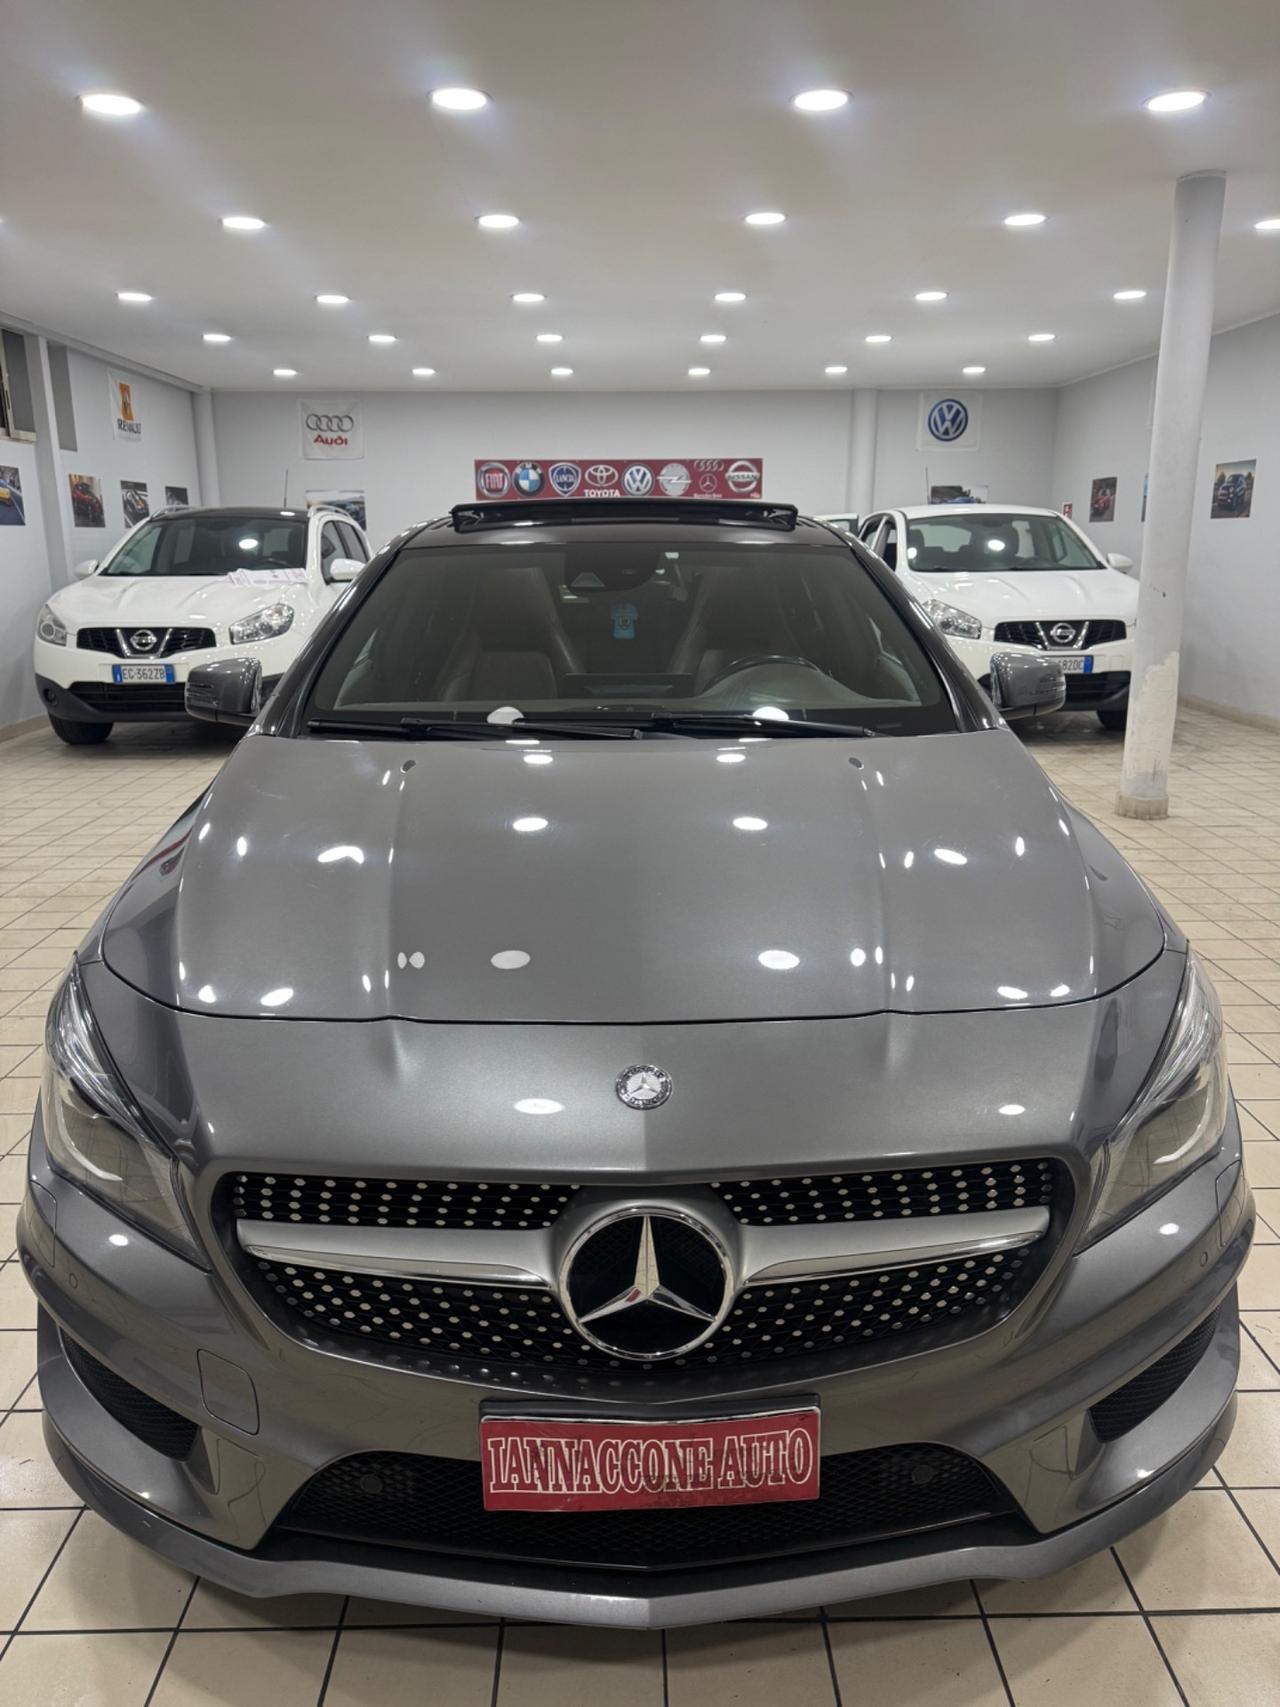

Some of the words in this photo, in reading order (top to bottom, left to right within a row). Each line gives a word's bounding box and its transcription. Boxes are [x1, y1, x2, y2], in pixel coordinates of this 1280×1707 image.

[313, 434, 348, 446] Audi
[485, 473, 504, 489] FIAT
[727, 474, 758, 482] NISSAN
[584, 489, 621, 498] TOYOTA
[488, 1436, 713, 1494] IANNACCONE
[717, 1427, 814, 1489] AUTO
